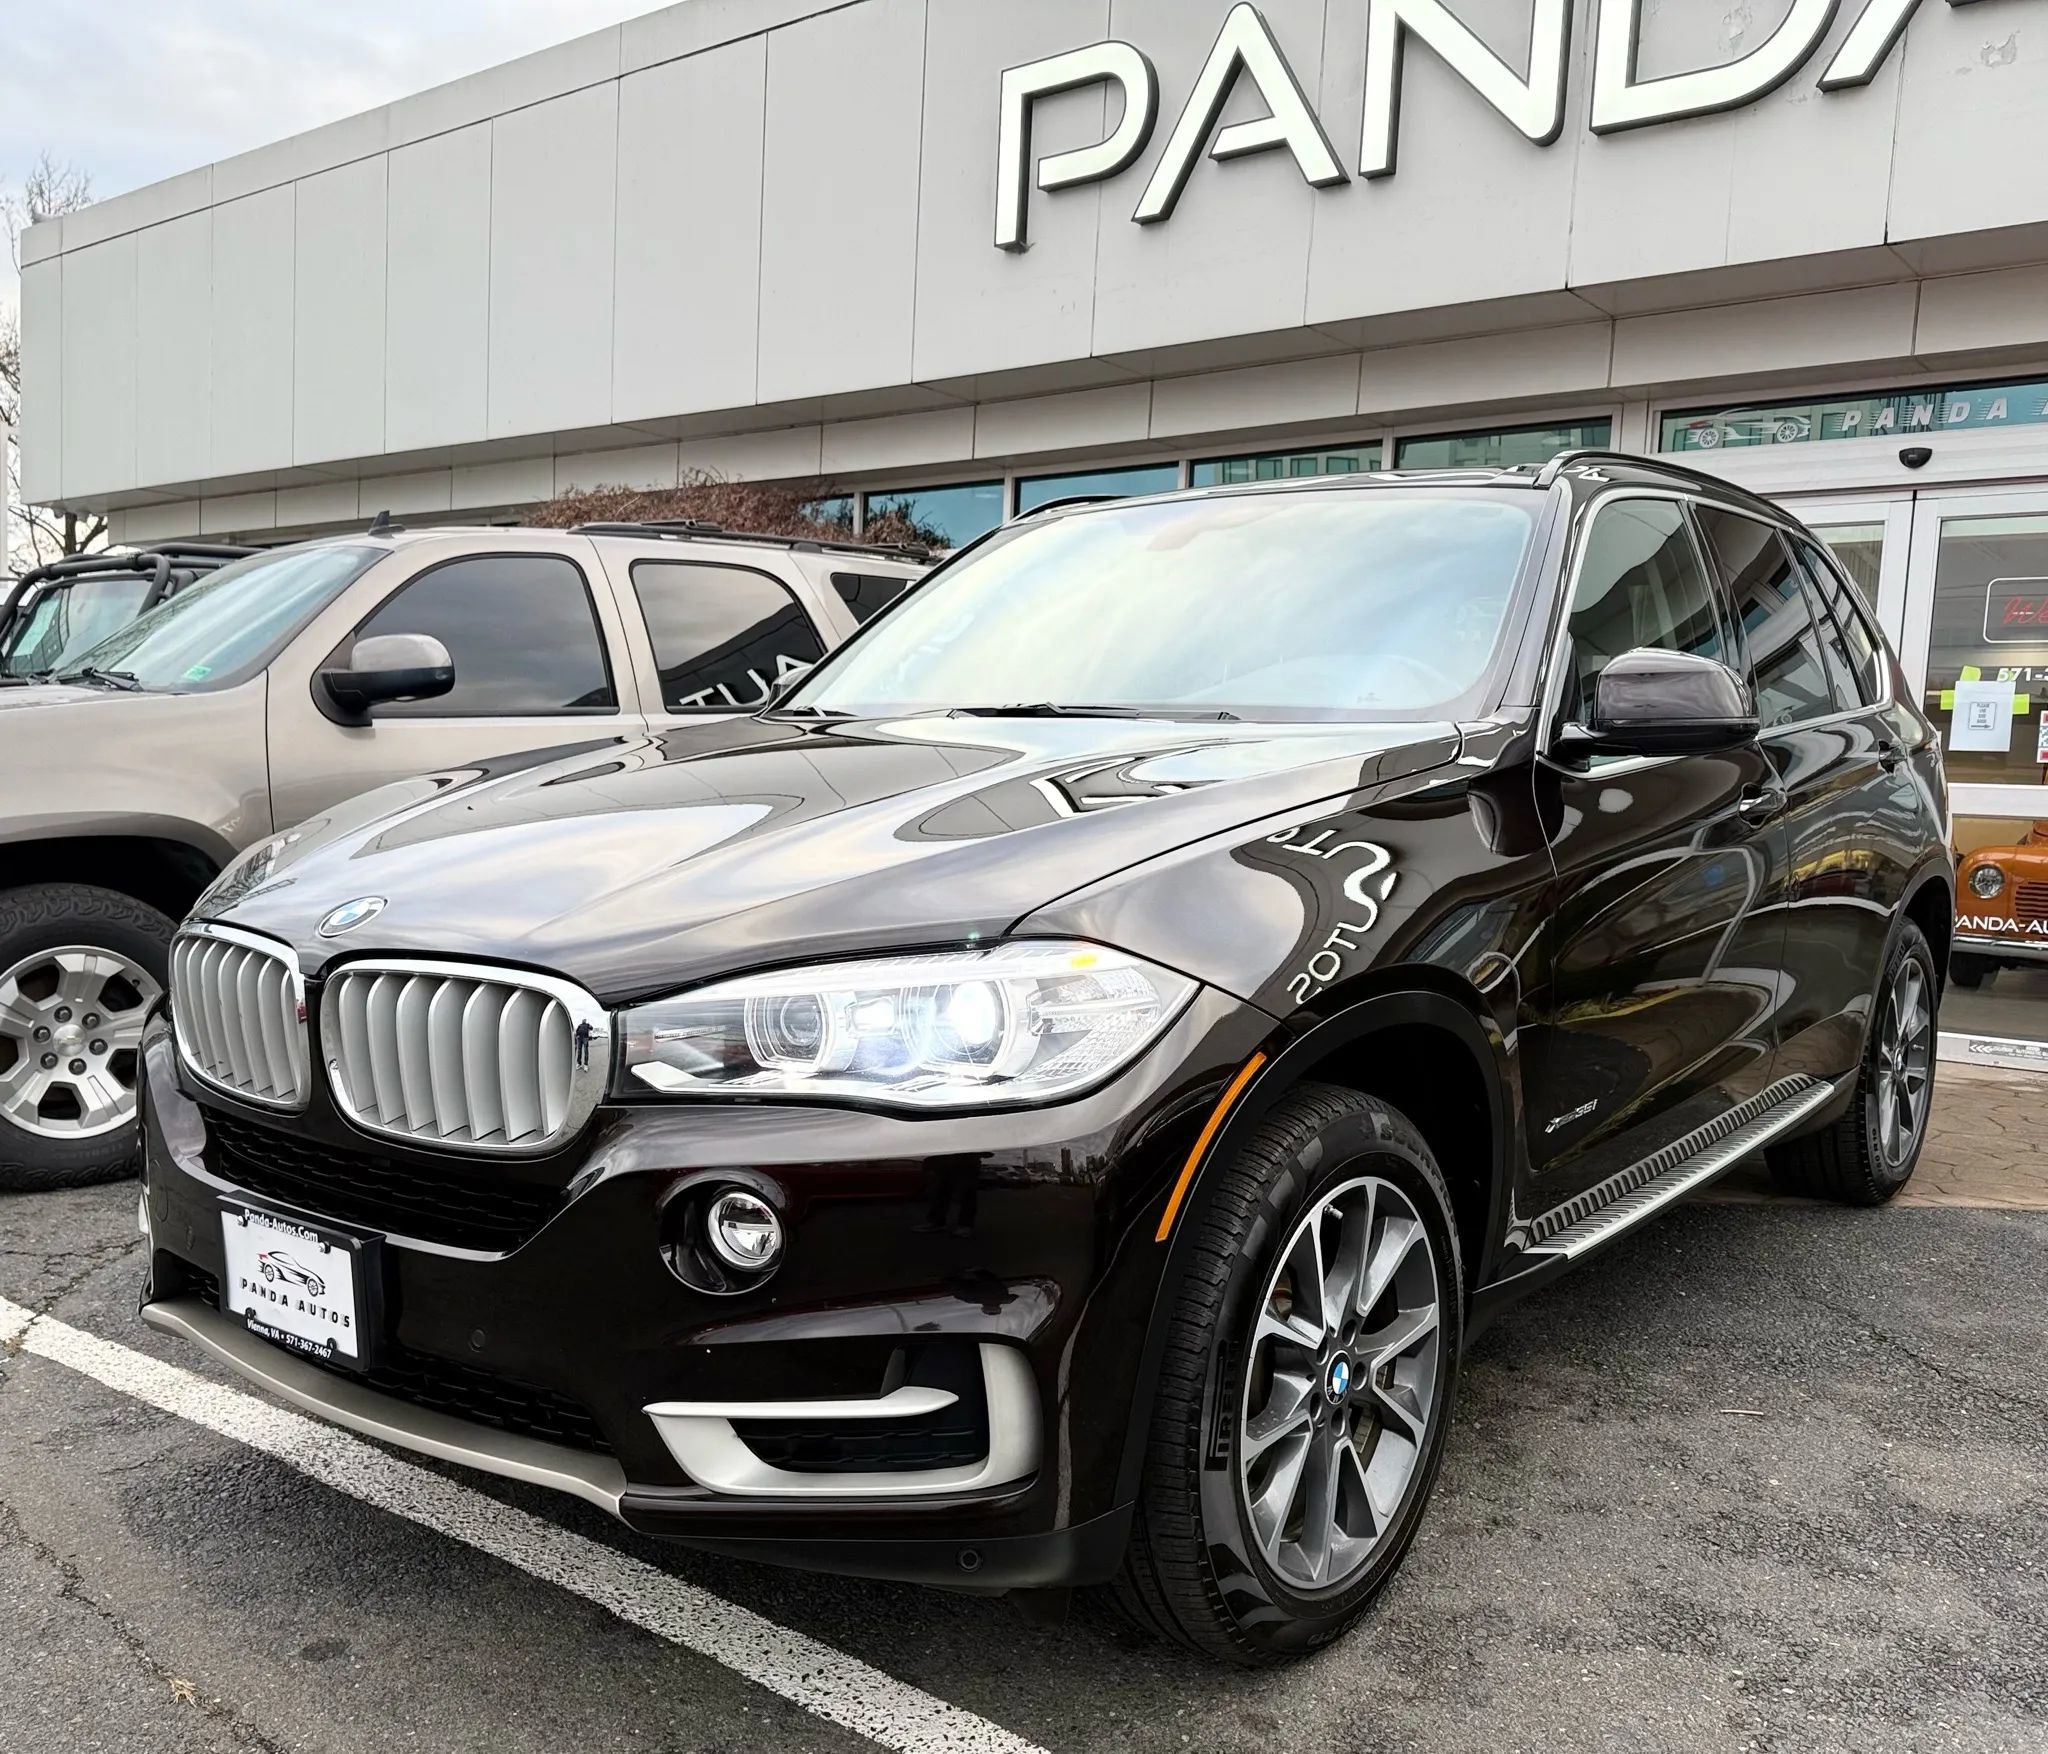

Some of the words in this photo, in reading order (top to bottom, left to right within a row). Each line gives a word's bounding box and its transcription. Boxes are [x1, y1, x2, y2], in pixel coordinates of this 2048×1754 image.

[1834, 397, 2008, 431] PANDA
[1955, 909, 2048, 935] ANDA-A
[244, 1208, 319, 1243] Panda-Autos.Com
[240, 1277, 289, 1307] PANDA
[295, 1300, 350, 1328] AUTOS
[270, 1328, 280, 1340] VA
[286, 1334, 332, 1358] 571-367-2467
